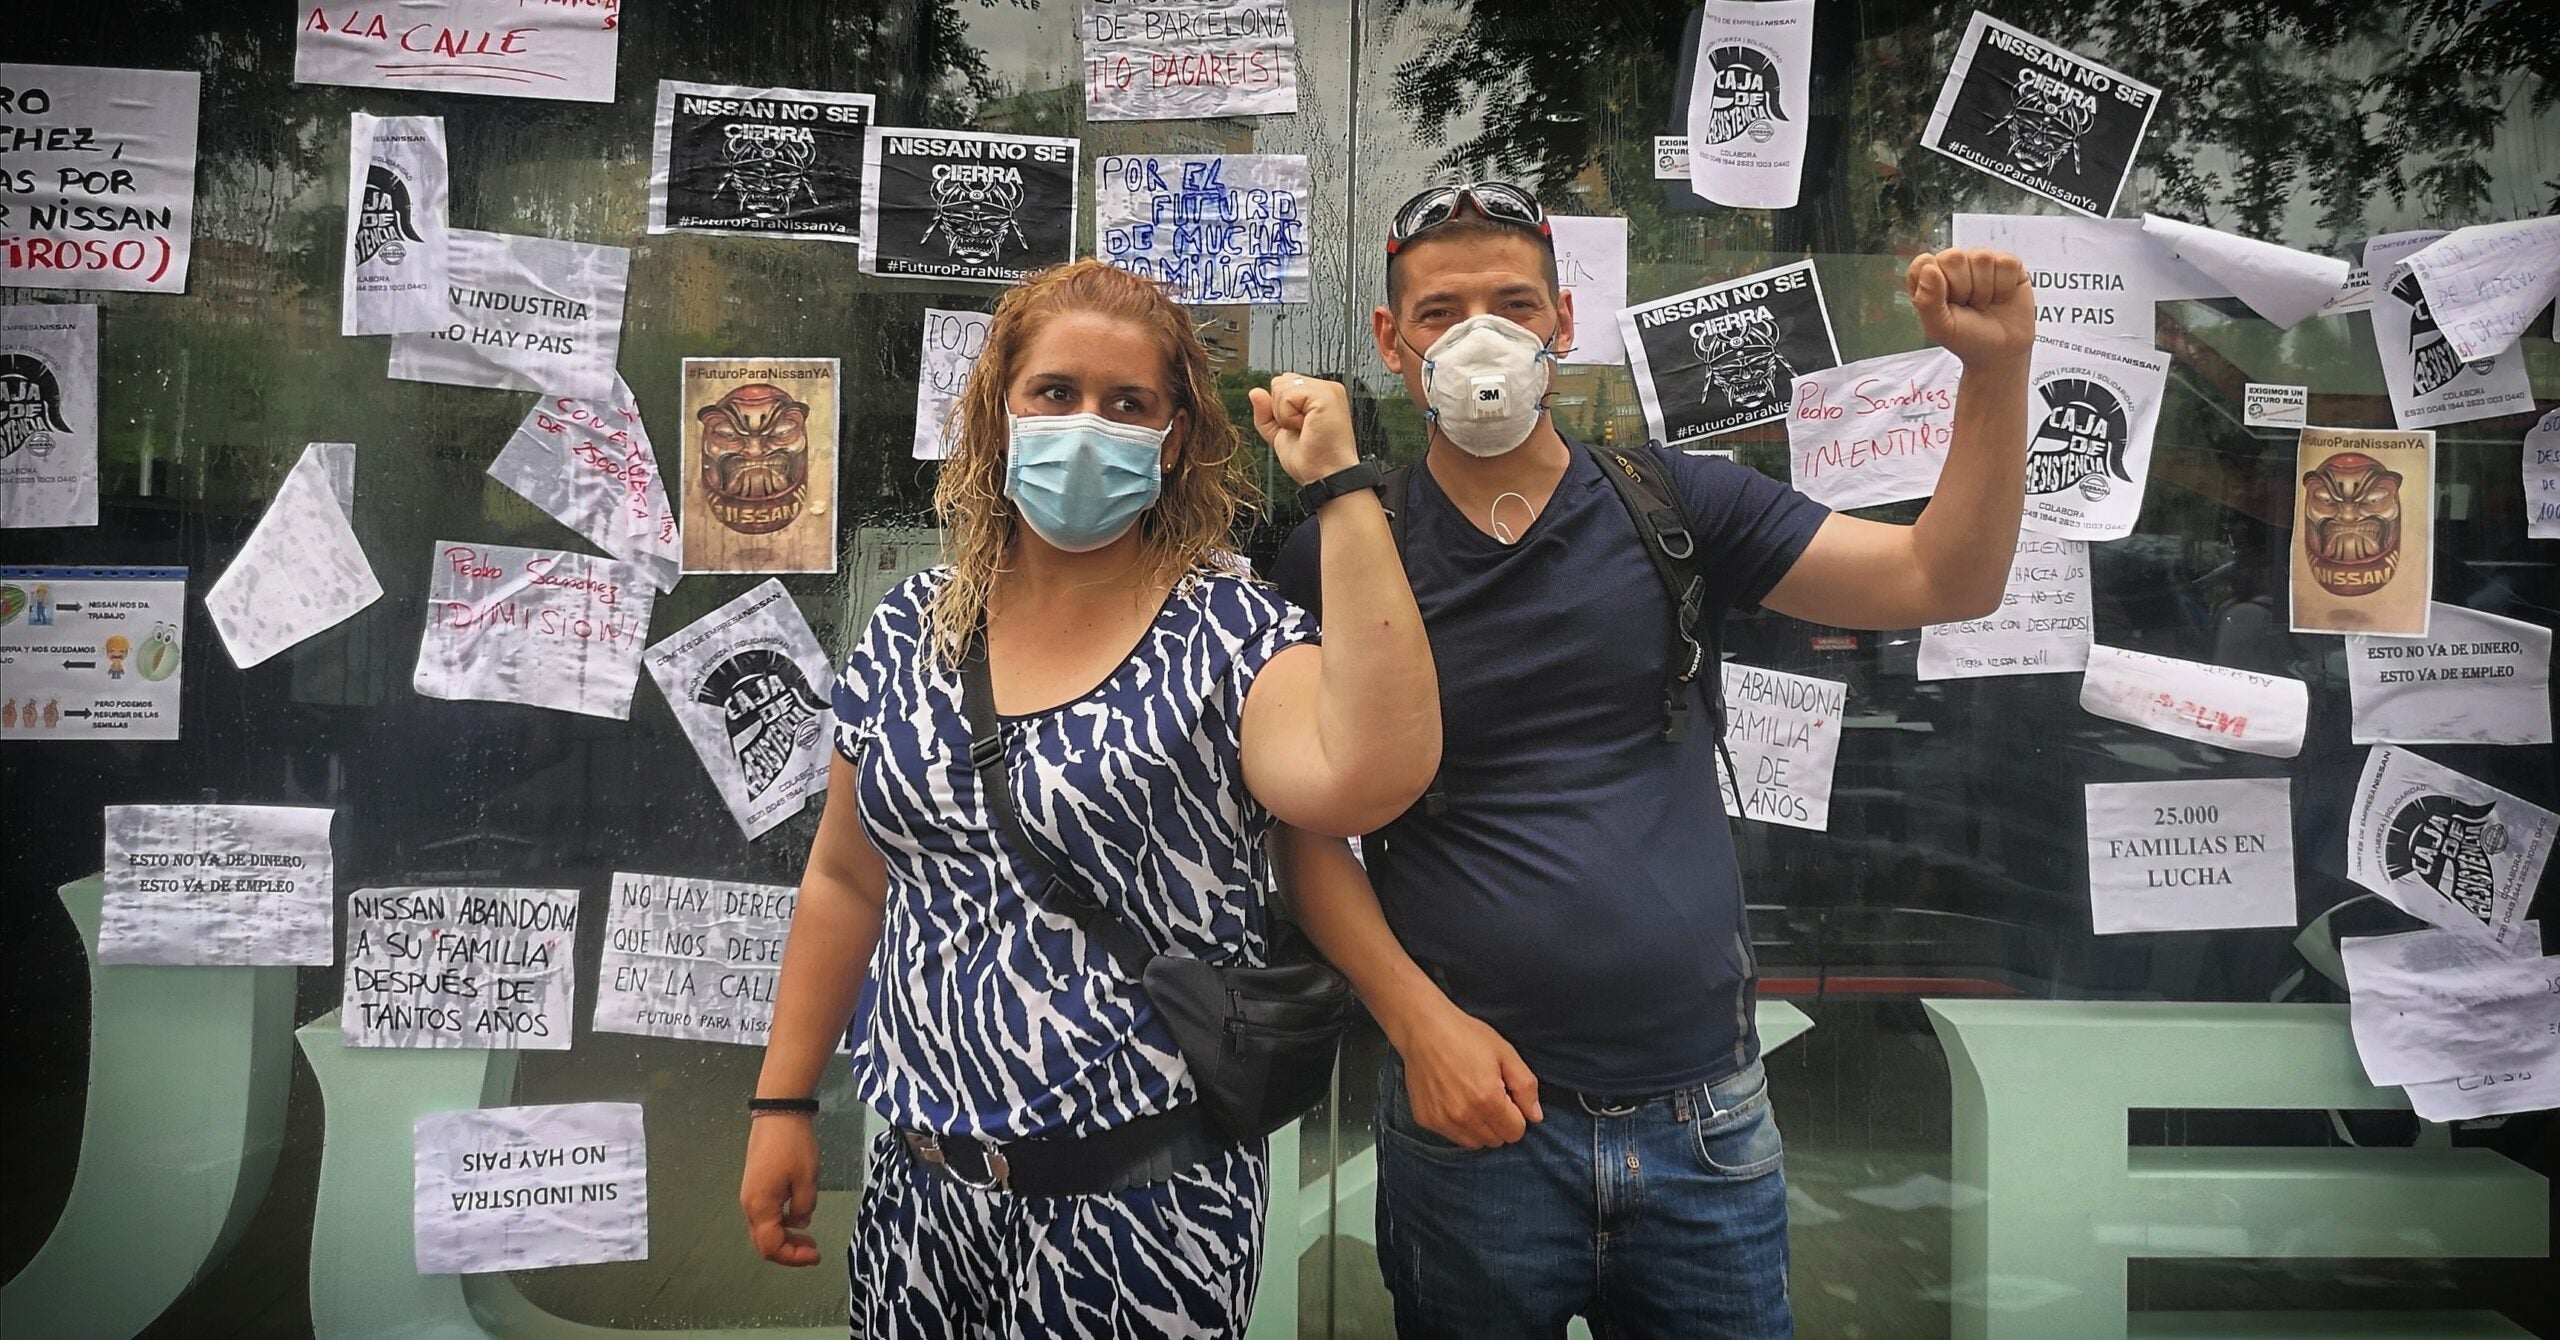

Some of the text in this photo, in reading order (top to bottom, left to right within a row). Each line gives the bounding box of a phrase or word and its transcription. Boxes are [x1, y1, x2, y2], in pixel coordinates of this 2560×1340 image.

[305, 7, 387, 40] A LA
[1096, 8, 1288, 41] DE BARCELONA
[400, 24, 539, 58] CALLE
[1717, 70, 1763, 91] CAJA
[1988, 29, 2148, 109] NISSAN NO SE
[1735, 93, 1764, 106] DE
[2018, 67, 2097, 115] CIERRA
[683, 97, 860, 124] NISSAN NO SE
[723, 123, 816, 144] CIERRA
[1708, 106, 1768, 143] RESISTENCIA
[889, 137, 1068, 163] NISSAN NO SE
[57, 167, 136, 194] POR
[931, 163, 1024, 185] CIERRA
[1103, 157, 1226, 193] POR EL
[1948, 140, 2098, 212] #FuturoParaNissanYa
[361, 213, 397, 227] DE
[679, 215, 847, 233] #FuturoParaNissanYa
[1106, 219, 1304, 259] DE MUCHAS
[2350, 279, 2372, 289] REAL
[469, 290, 588, 320] INDUSTRIA
[1641, 271, 1807, 329] NISSAN NO SE
[1688, 305, 1775, 340] CIERRA
[2071, 307, 2115, 325] PAIS
[471, 327, 574, 355] HAY PAIS
[2071, 344, 2084, 353] DE
[688, 367, 831, 380] #FuturoParaNissanYA
[1479, 388, 1500, 402] 3M
[1796, 379, 1951, 420] Pedro Sanchez
[2061, 367, 2092, 377] FUERZA
[2096, 373, 2136, 413] SOLIDARIDAD
[2248, 396, 2305, 406] FUTURO REAL
[2249, 387, 2289, 396] EXIGIMOS
[2442, 388, 2486, 401] COLABORA
[9, 403, 42, 418] DE
[2048, 405, 2108, 439] CAJA
[2069, 434, 2107, 456] DE
[714, 499, 802, 524] NISSAN
[2038, 501, 2086, 519] COLABORA
[444, 546, 619, 605] Pedro Sanchez
[2015, 566, 2085, 582] HACIA LOS
[2312, 566, 2392, 586] NISSAN
[88, 601, 150, 610] NISSAN NOS DA
[2031, 590, 2076, 605] NO SE
[88, 612, 126, 621] TRABAJO
[2000, 621, 2021, 631] CON
[32, 646, 97, 654] NOS QUEDAMOS
[656, 634, 706, 667] COMITÉS DE
[702, 648, 730, 670] FUERZA
[2368, 641, 2524, 660] ESTO NO VA DE DINERO,
[2380, 665, 2516, 684] ESTO VA DE EMPLEO
[94, 700, 154, 709] PERO PODEMOS
[724, 674, 786, 720] CAJA
[760, 692, 796, 724] DE
[1738, 671, 1842, 721] ABANDONA
[92, 721, 129, 730] SEMILLAS
[94, 711, 160, 720] RESURGIR DE LAS
[742, 706, 812, 796] RESISTENCIA
[1757, 756, 1791, 789] DE
[1745, 786, 1809, 822] AÑOS
[2153, 804, 2220, 826] 25.000
[2109, 834, 2266, 859] FAMILIAS EN
[2411, 814, 2450, 876] CAJA
[2441, 820, 2465, 859] DE
[129, 851, 307, 870] ESTO NO VA DE DINERO,
[2453, 825, 2493, 920] RESISTENCIA
[139, 878, 295, 894] ESTO VA DE EMPLEO
[2147, 866, 2233, 888] LUCHA
[2500, 854, 2524, 901] COLABORA
[622, 882, 652, 909] NO
[664, 885, 710, 913] HAY
[354, 895, 577, 932] NISSAN ABANDONA
[356, 929, 422, 960] A SU
[613, 927, 652, 954] QUE
[664, 932, 706, 958] NOS
[354, 965, 535, 1004] DESPUÉS DE
[614, 966, 648, 993] EN
[664, 969, 697, 997] LA
[360, 1002, 549, 1037] TANTOS AÑOS
[636, 1009, 733, 1030] FUTURO PARA
[462, 1144, 607, 1173] NO HAY PAIS
[451, 1181, 619, 1212] SIN INDUSTRIA
